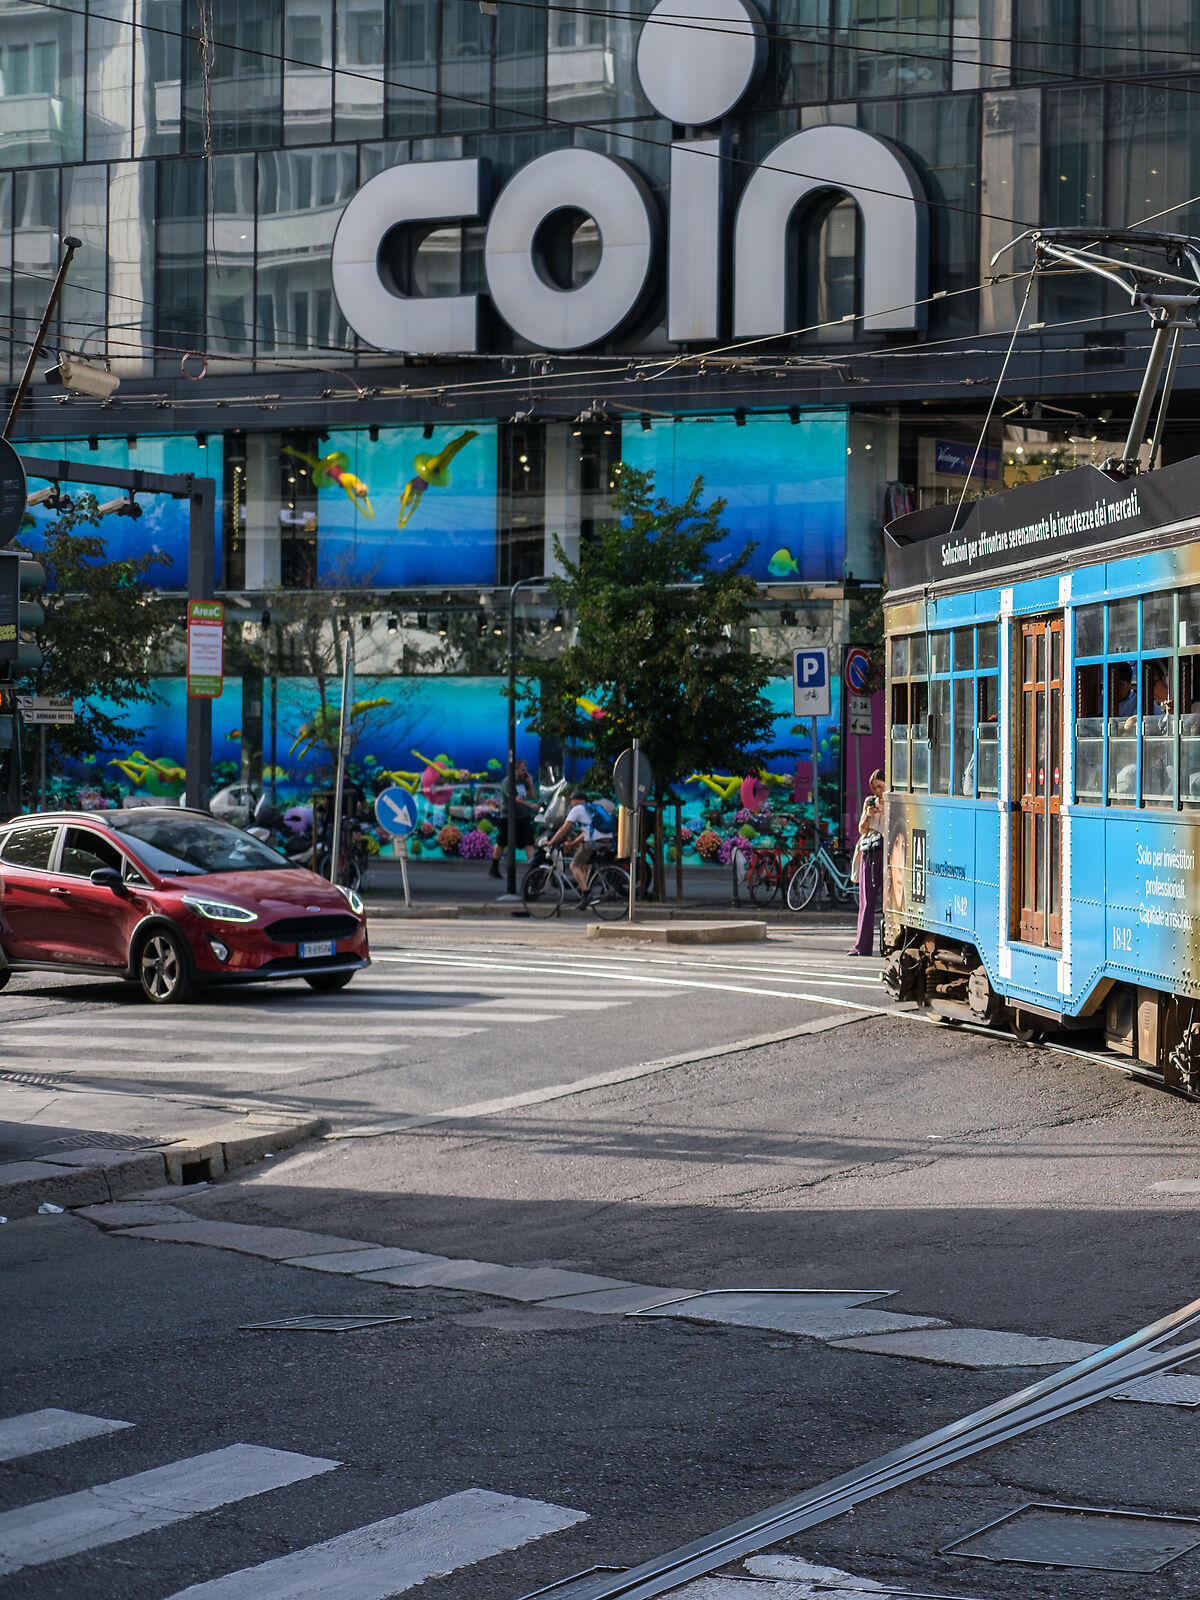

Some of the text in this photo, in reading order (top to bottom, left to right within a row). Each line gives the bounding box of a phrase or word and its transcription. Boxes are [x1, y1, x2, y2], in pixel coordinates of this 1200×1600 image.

[332, 0, 919, 352] coin
[941, 488, 1141, 566] Soluzioni per affrontare serenamente le incertezze dei mercati.
[803, 657, 819, 683] P
[1138, 844, 1195, 871] Solo per investitori
[954, 894, 968, 917] 1842
[1113, 926, 1132, 952] 1842
